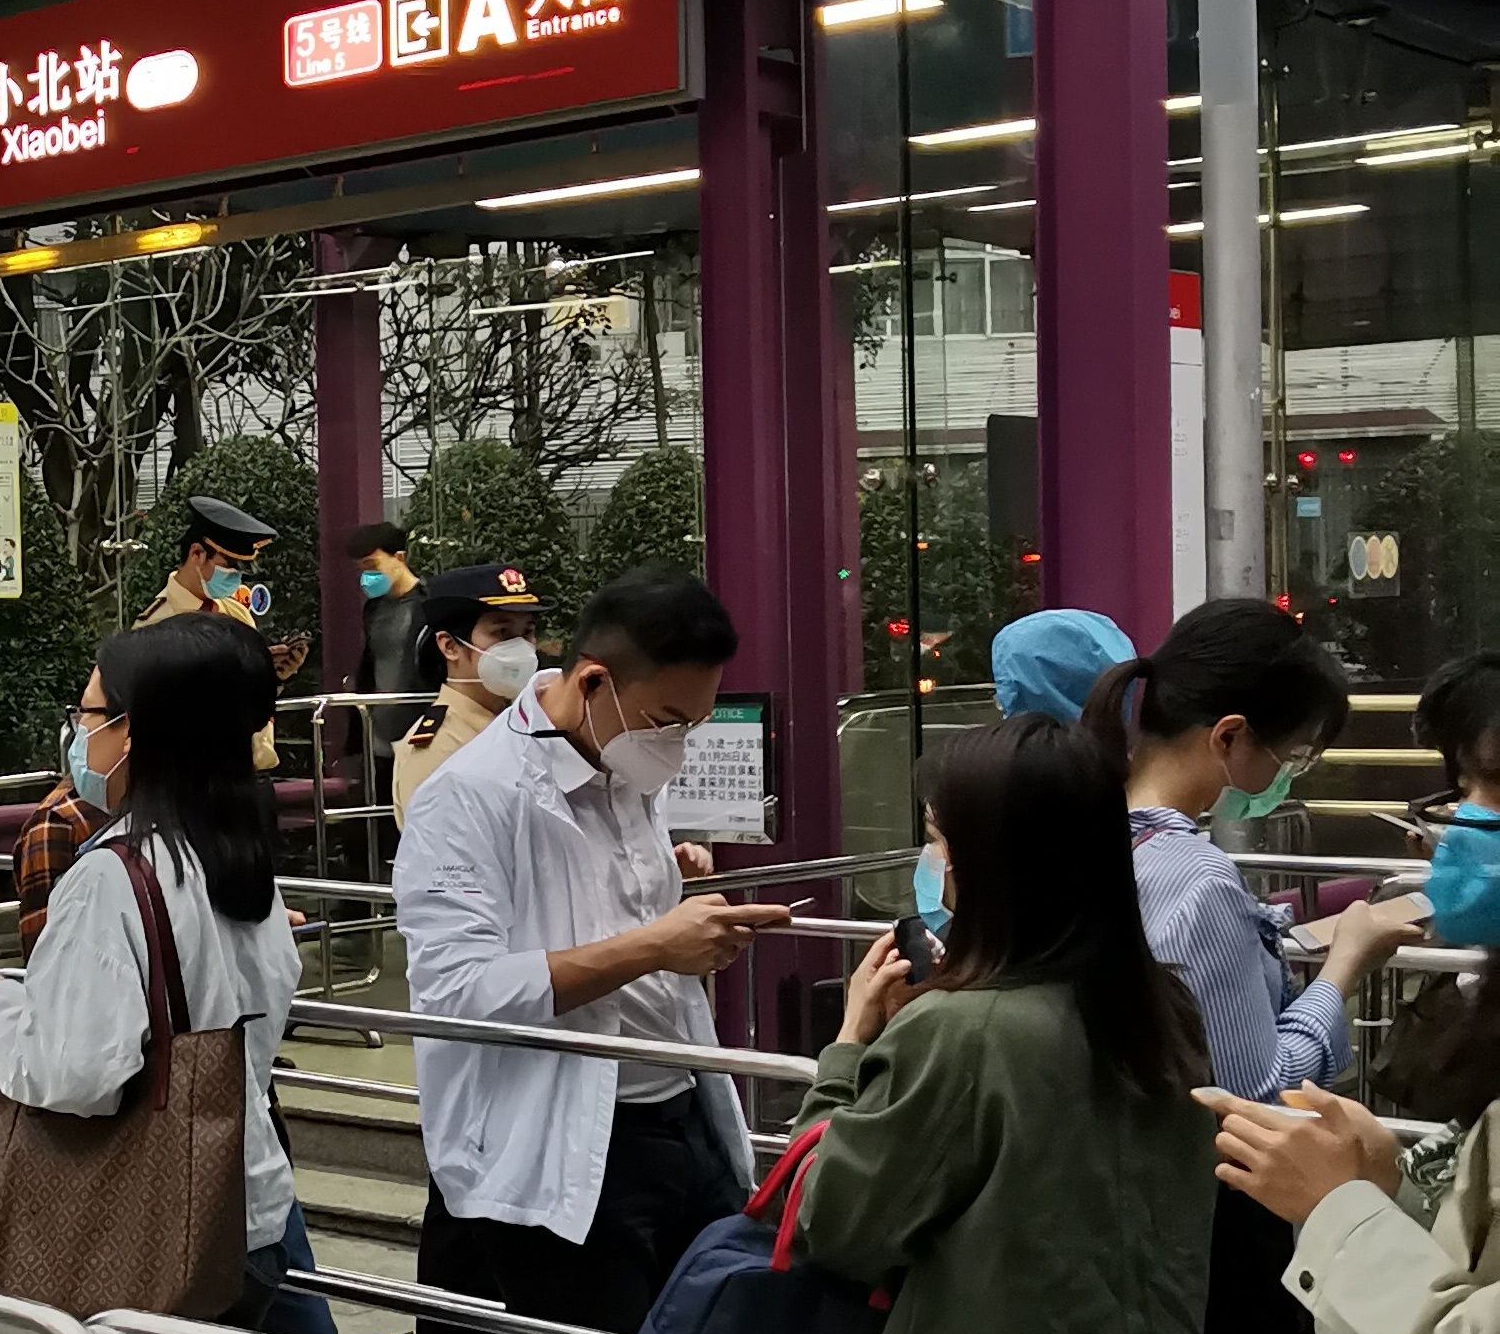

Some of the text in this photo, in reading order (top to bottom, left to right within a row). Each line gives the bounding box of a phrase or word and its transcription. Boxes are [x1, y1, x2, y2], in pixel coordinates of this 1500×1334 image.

[295, 11, 372, 57] 5号线
[526, 7, 621, 39] Entrance
[296, 51, 346, 77] Line 5
[1, 108, 106, 165] Xiaobei
[711, 708, 745, 720] OTICE
